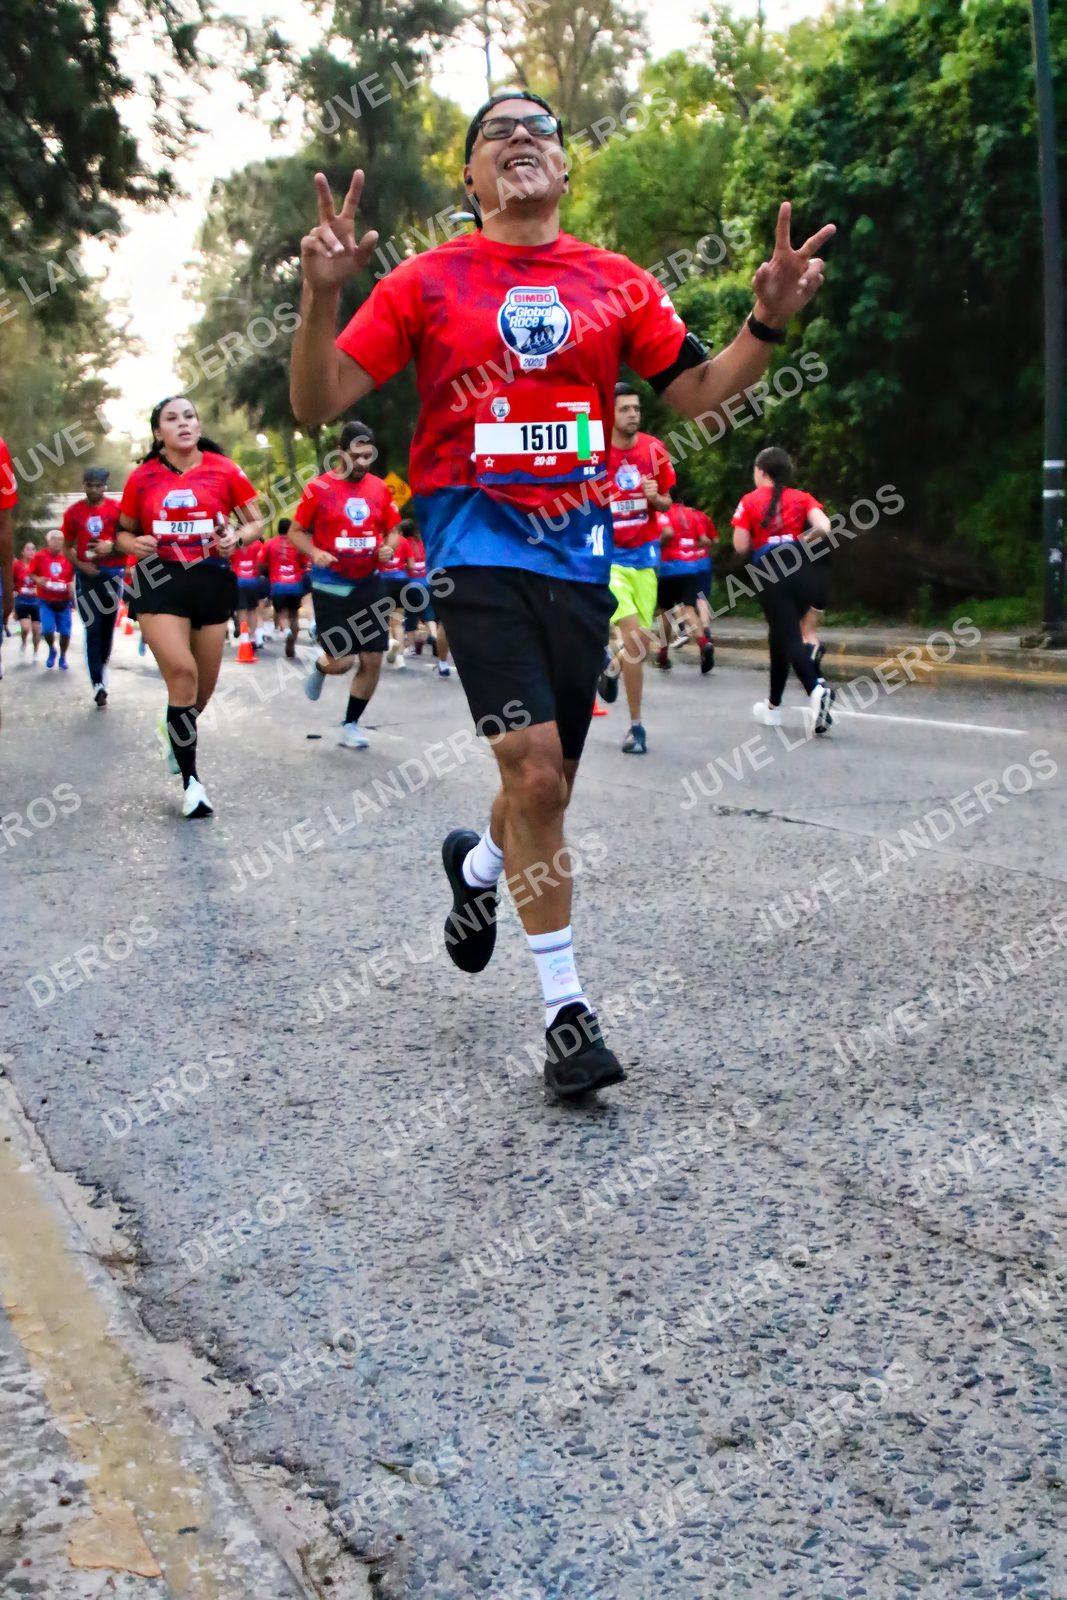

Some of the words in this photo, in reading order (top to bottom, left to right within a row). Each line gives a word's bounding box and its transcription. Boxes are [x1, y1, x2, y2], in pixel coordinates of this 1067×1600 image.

[514, 294, 552, 302] BIMBO
[516, 306, 552, 317] Global
[509, 316, 540, 328] Race
[520, 424, 568, 451] 1510
[583, 466, 596, 475] 5K
[171, 522, 194, 534] 2477
